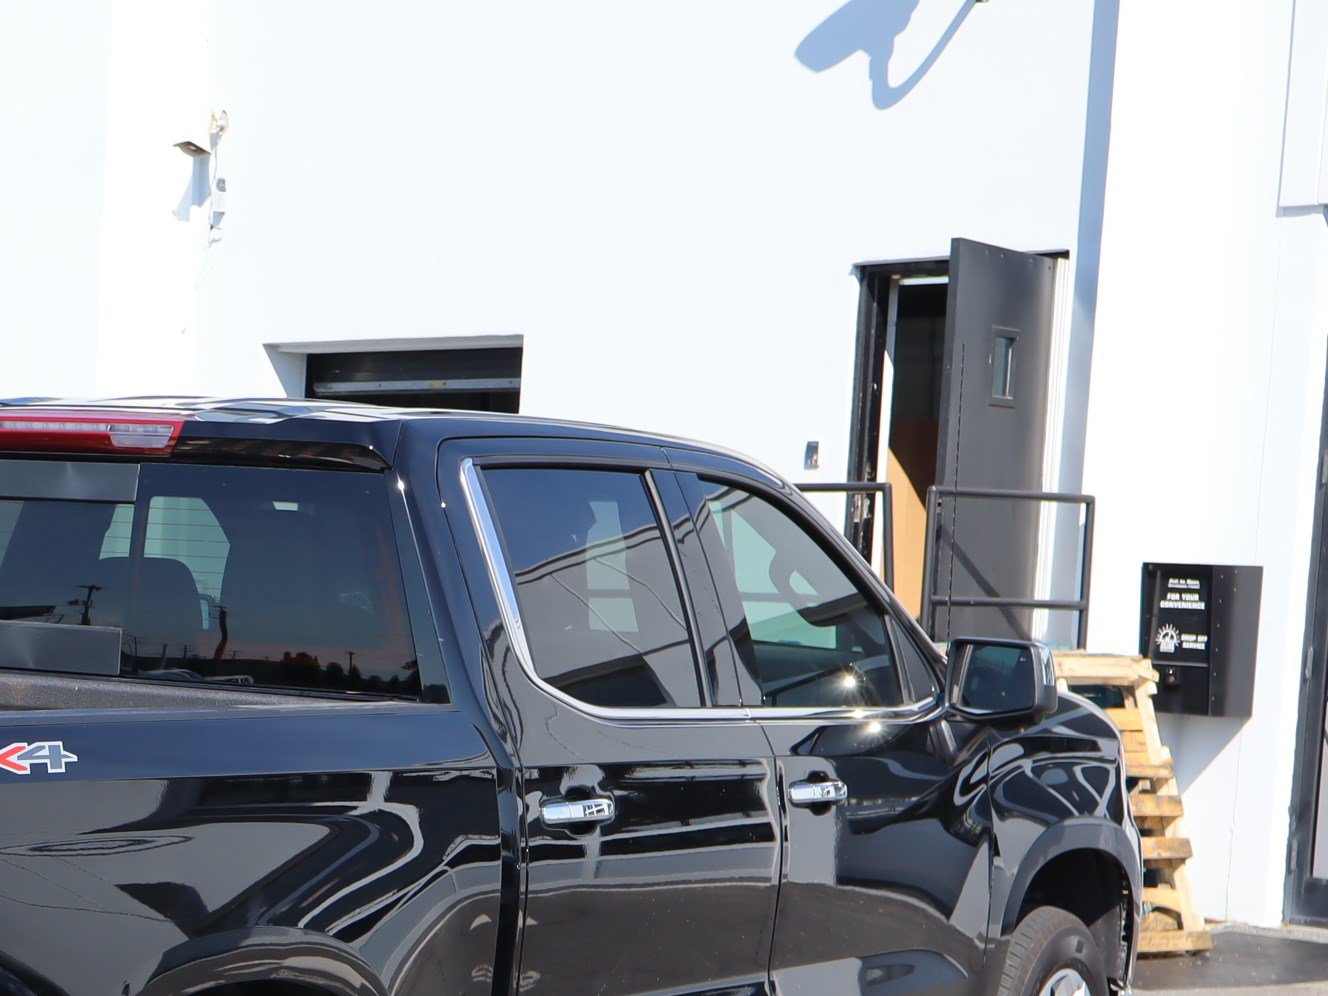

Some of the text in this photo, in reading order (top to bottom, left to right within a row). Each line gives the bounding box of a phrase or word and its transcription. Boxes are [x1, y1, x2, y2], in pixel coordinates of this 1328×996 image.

[1166, 592, 1199, 601] FOR YOUR
[1159, 601, 1205, 609] CONVENIENCE
